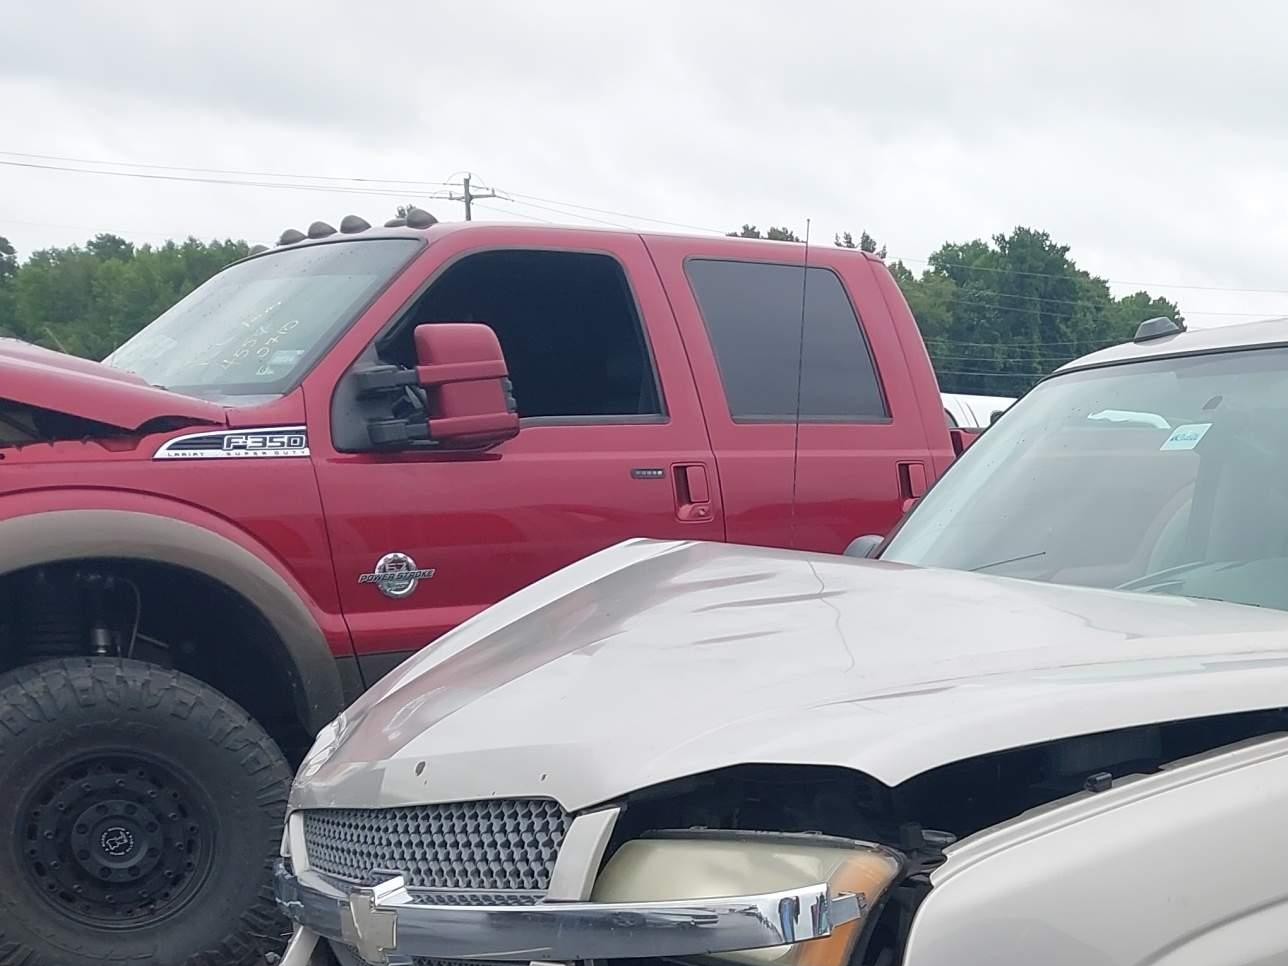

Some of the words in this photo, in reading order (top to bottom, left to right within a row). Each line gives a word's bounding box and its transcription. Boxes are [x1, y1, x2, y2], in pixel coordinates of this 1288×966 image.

[223, 434, 306, 450] F-350
[360, 573, 395, 583] POWER
[396, 569, 434, 581] STROKE
